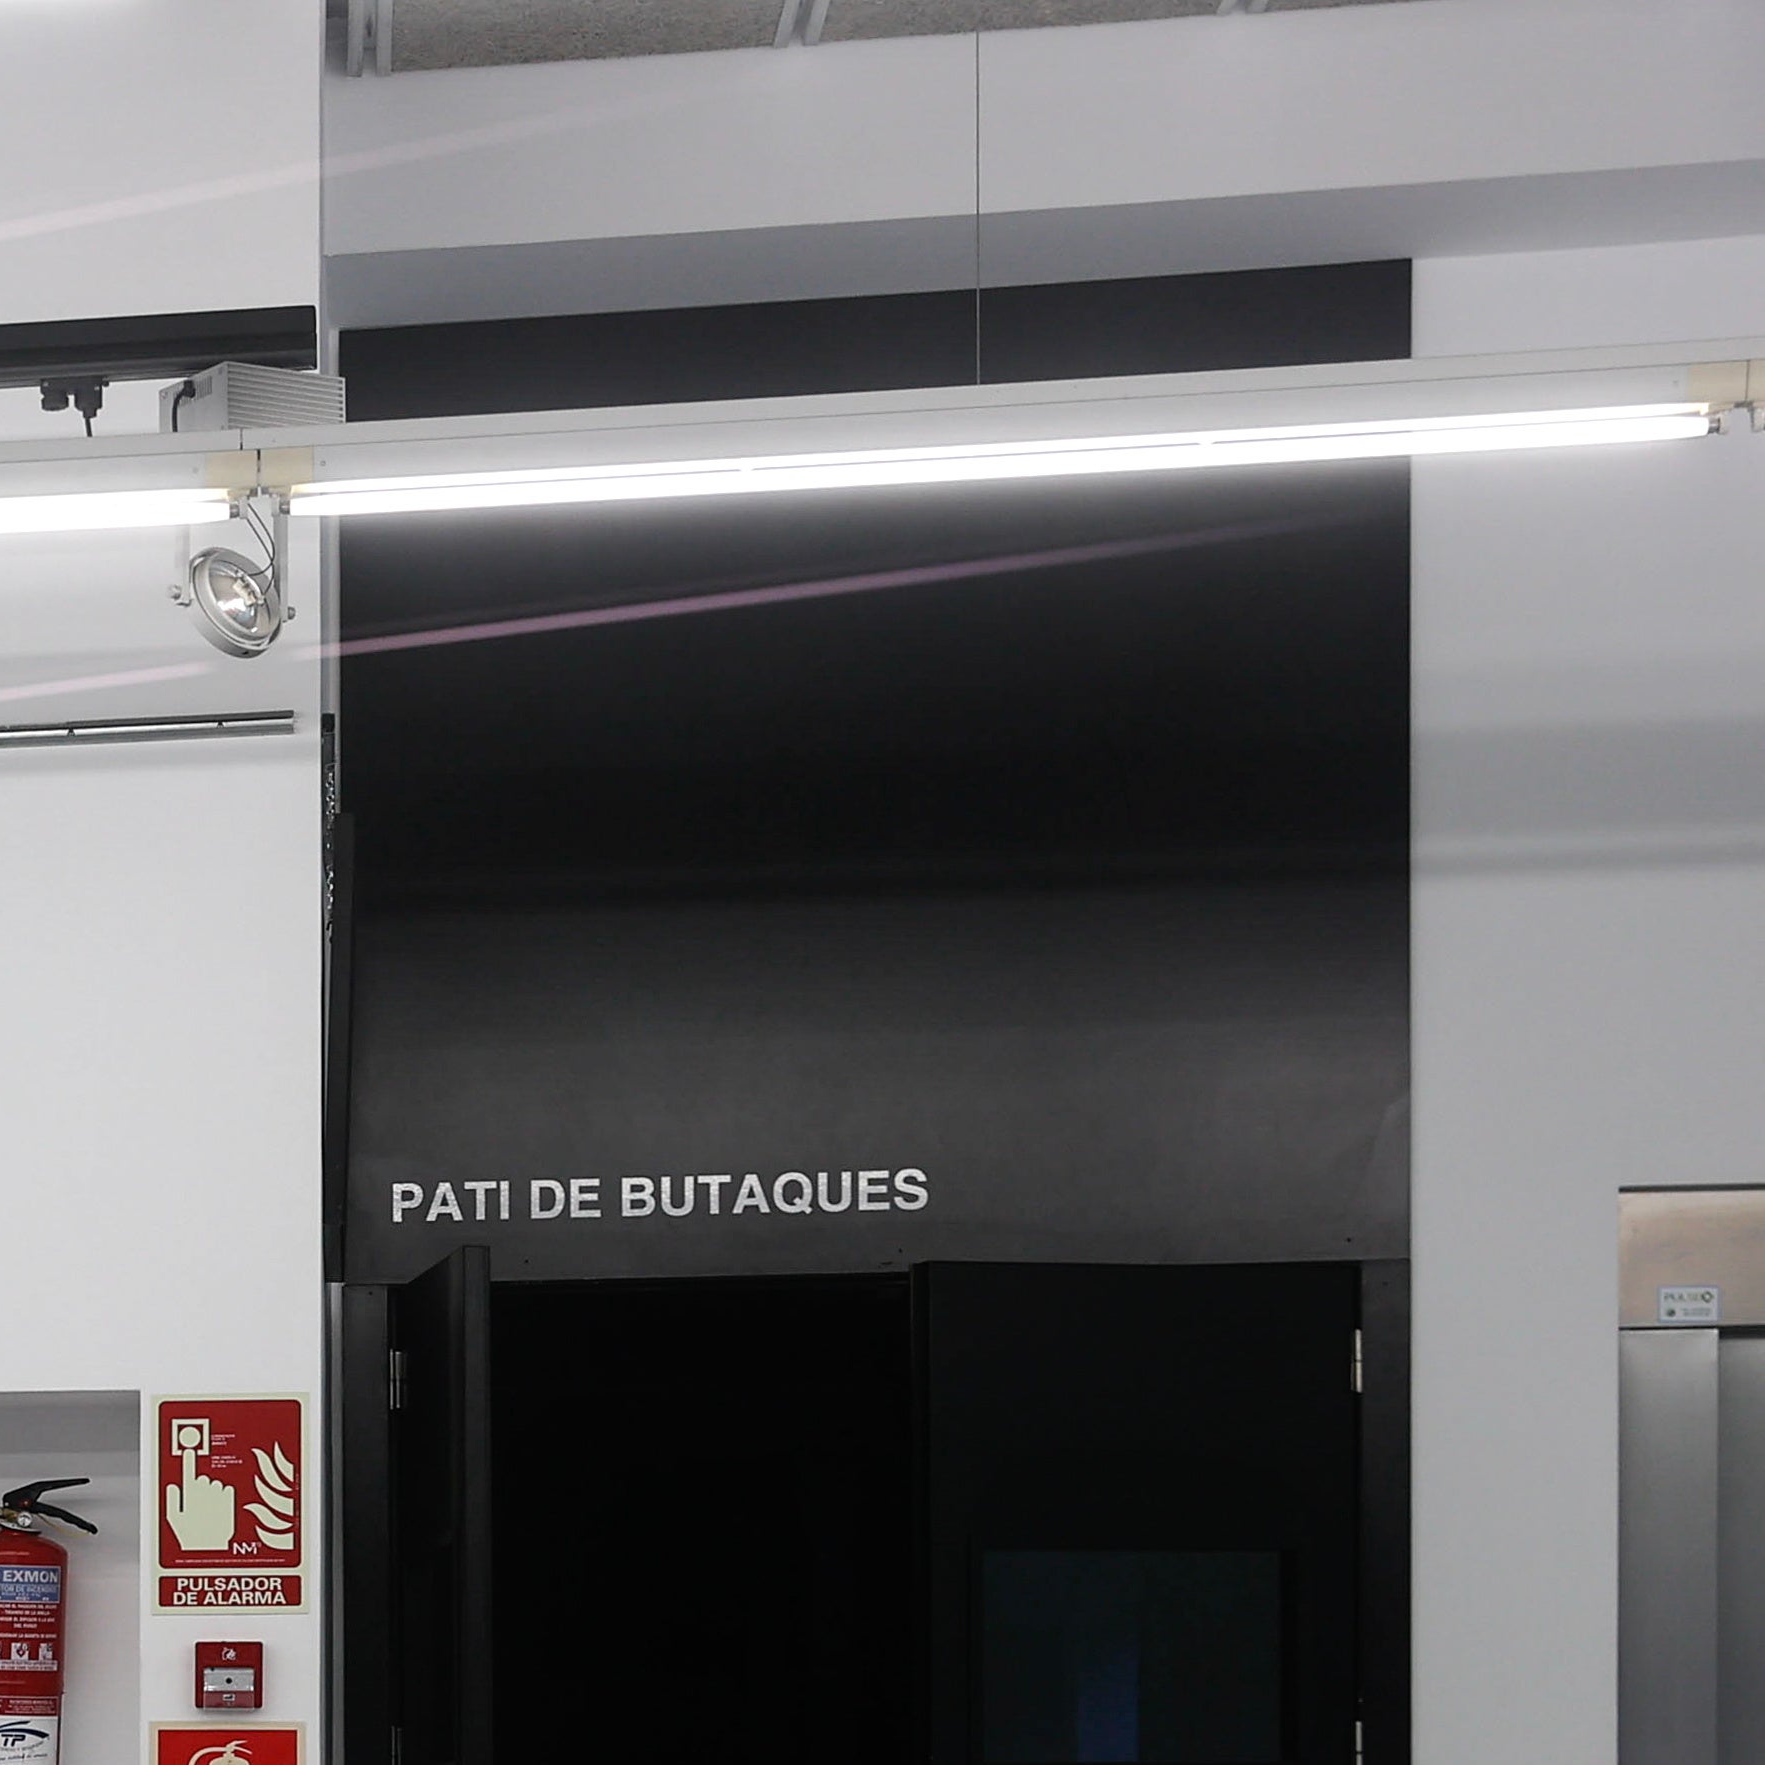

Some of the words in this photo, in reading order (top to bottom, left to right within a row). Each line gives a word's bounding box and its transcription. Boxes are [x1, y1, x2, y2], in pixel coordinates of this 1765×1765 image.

[392, 1181, 510, 1222] PATI
[530, 1178, 602, 1218] DE
[620, 1168, 929, 1217] BUTAQUES
[2, 1569, 58, 1583] EXMON
[177, 1577, 282, 1591] PULSADOR
[173, 1591, 198, 1605] DE
[203, 1591, 287, 1605] ALARMA
[0, 1733, 27, 1748] TP
